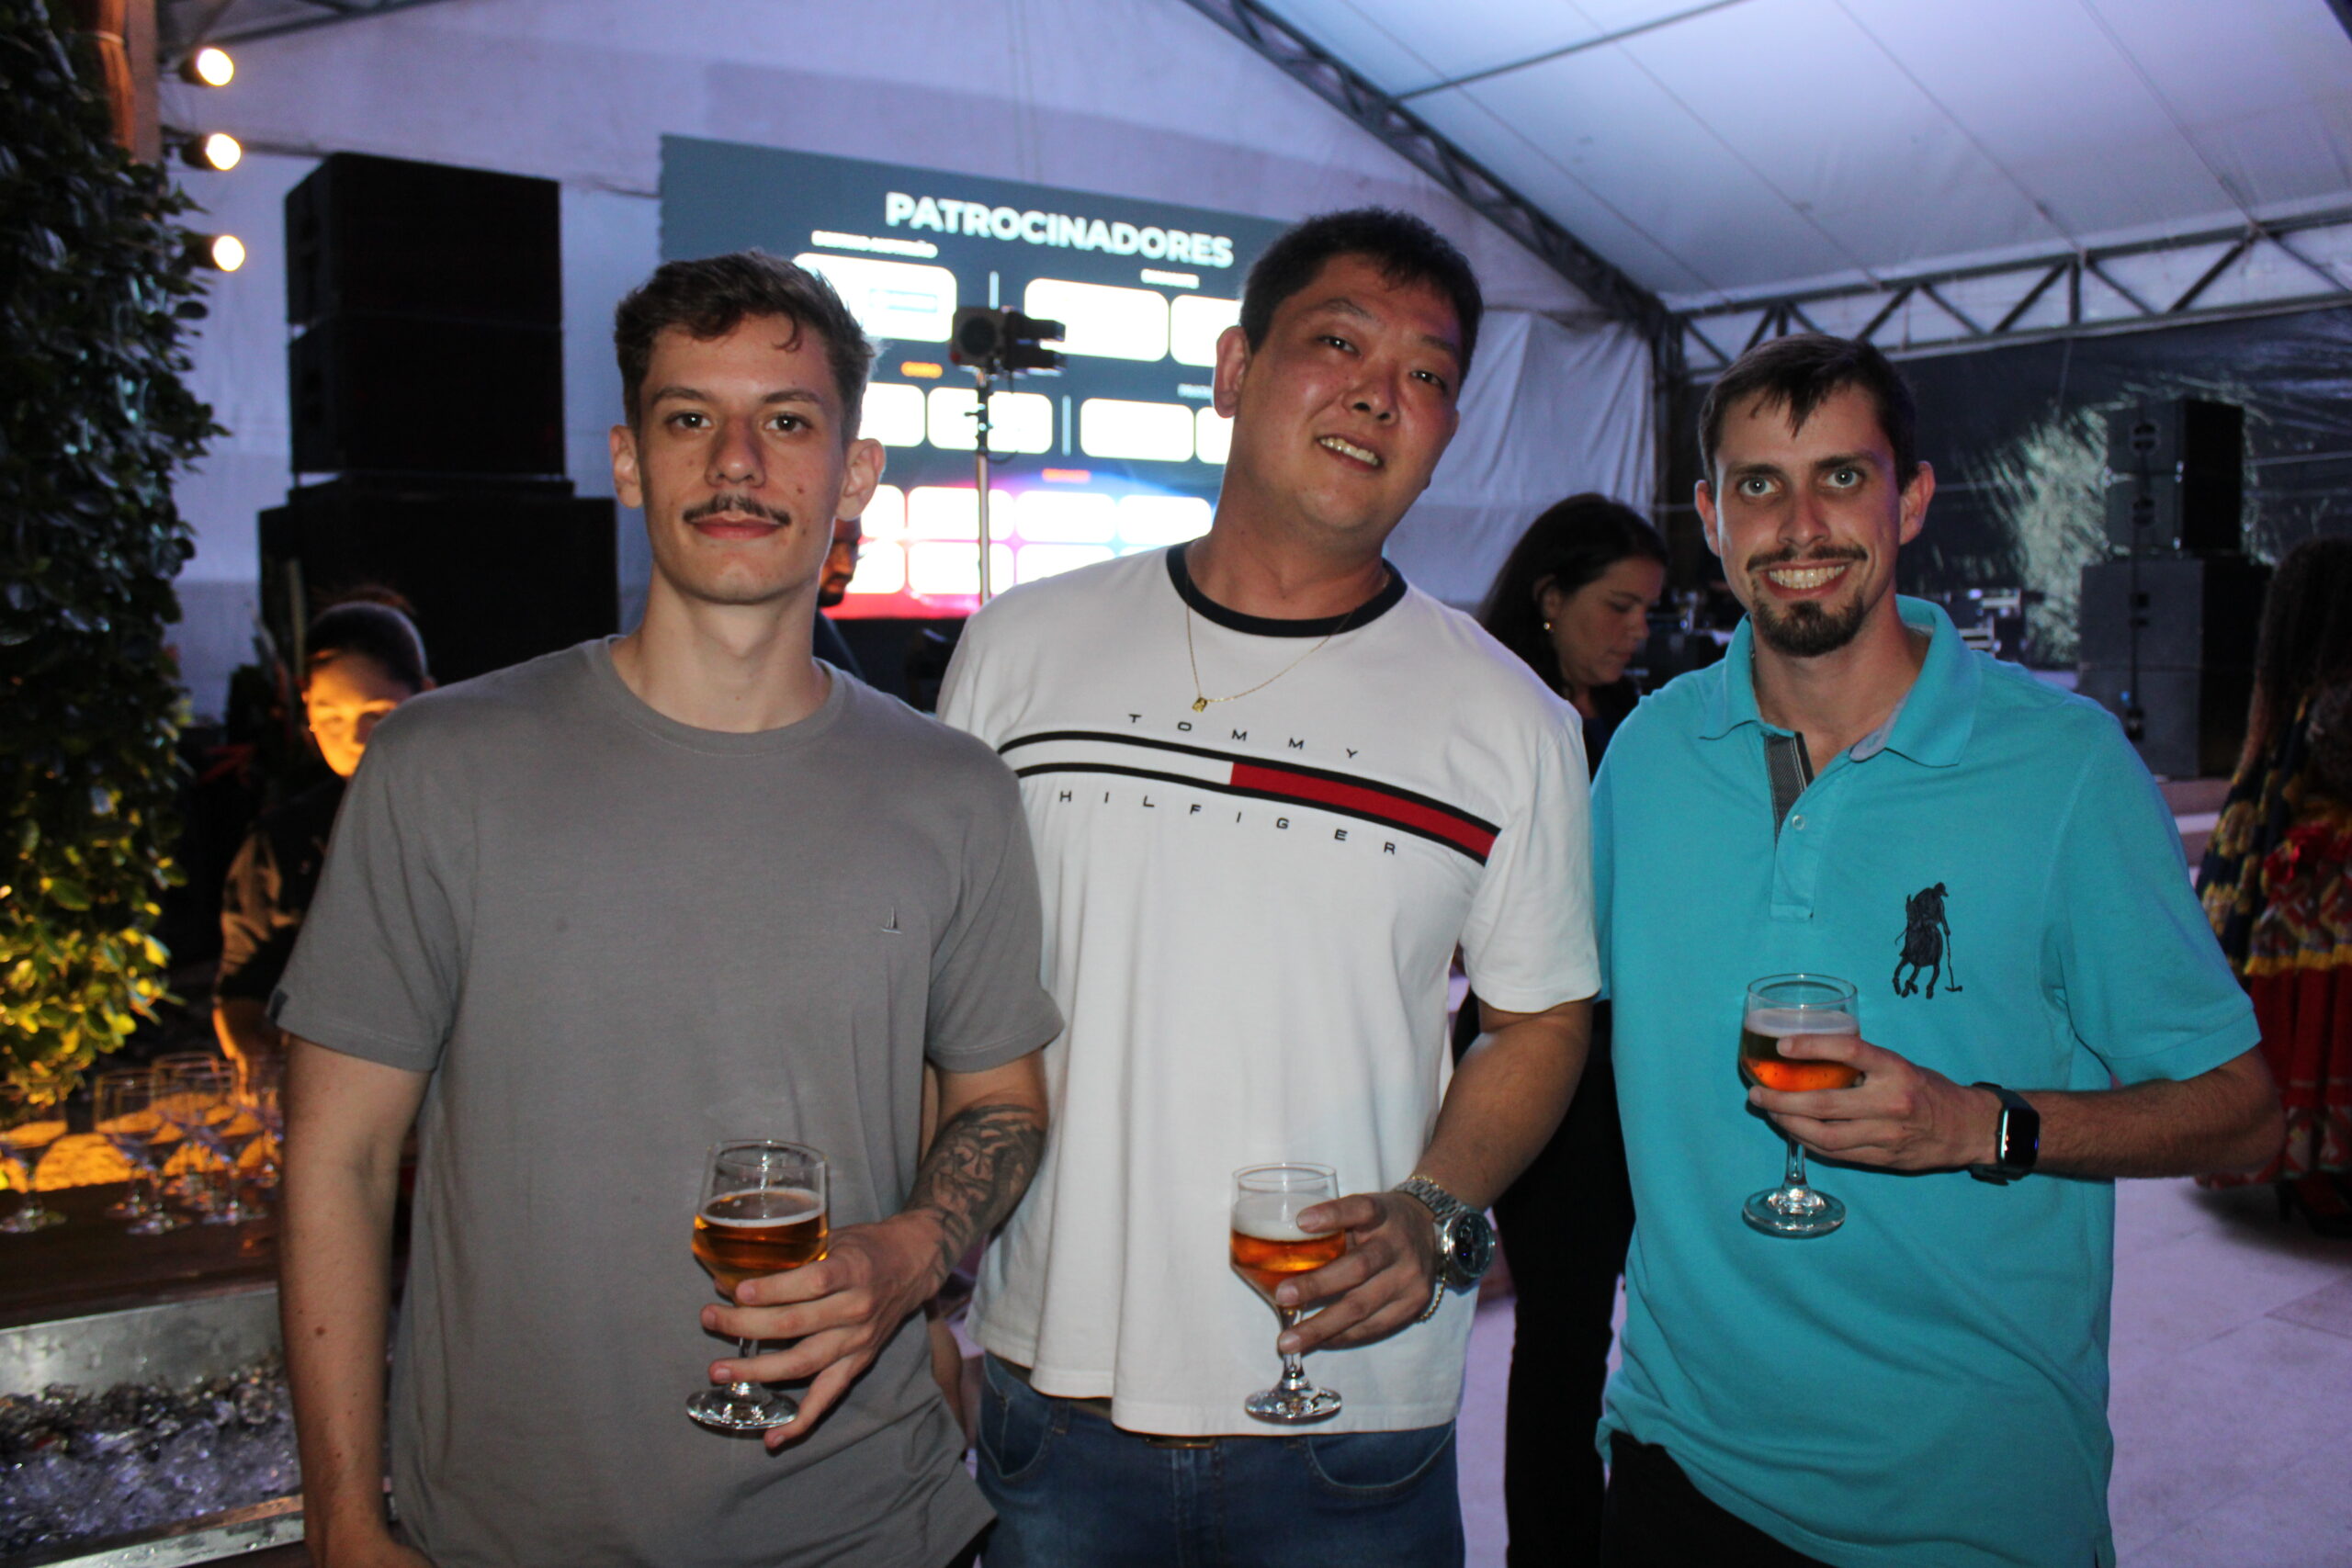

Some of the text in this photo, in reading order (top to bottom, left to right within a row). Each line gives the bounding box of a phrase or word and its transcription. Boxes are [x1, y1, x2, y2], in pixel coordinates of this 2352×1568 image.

[887, 192, 1234, 268] PATROCINADORES
[1129, 714, 1358, 760] TOMMY
[1059, 791, 1396, 855] HILFIGER
